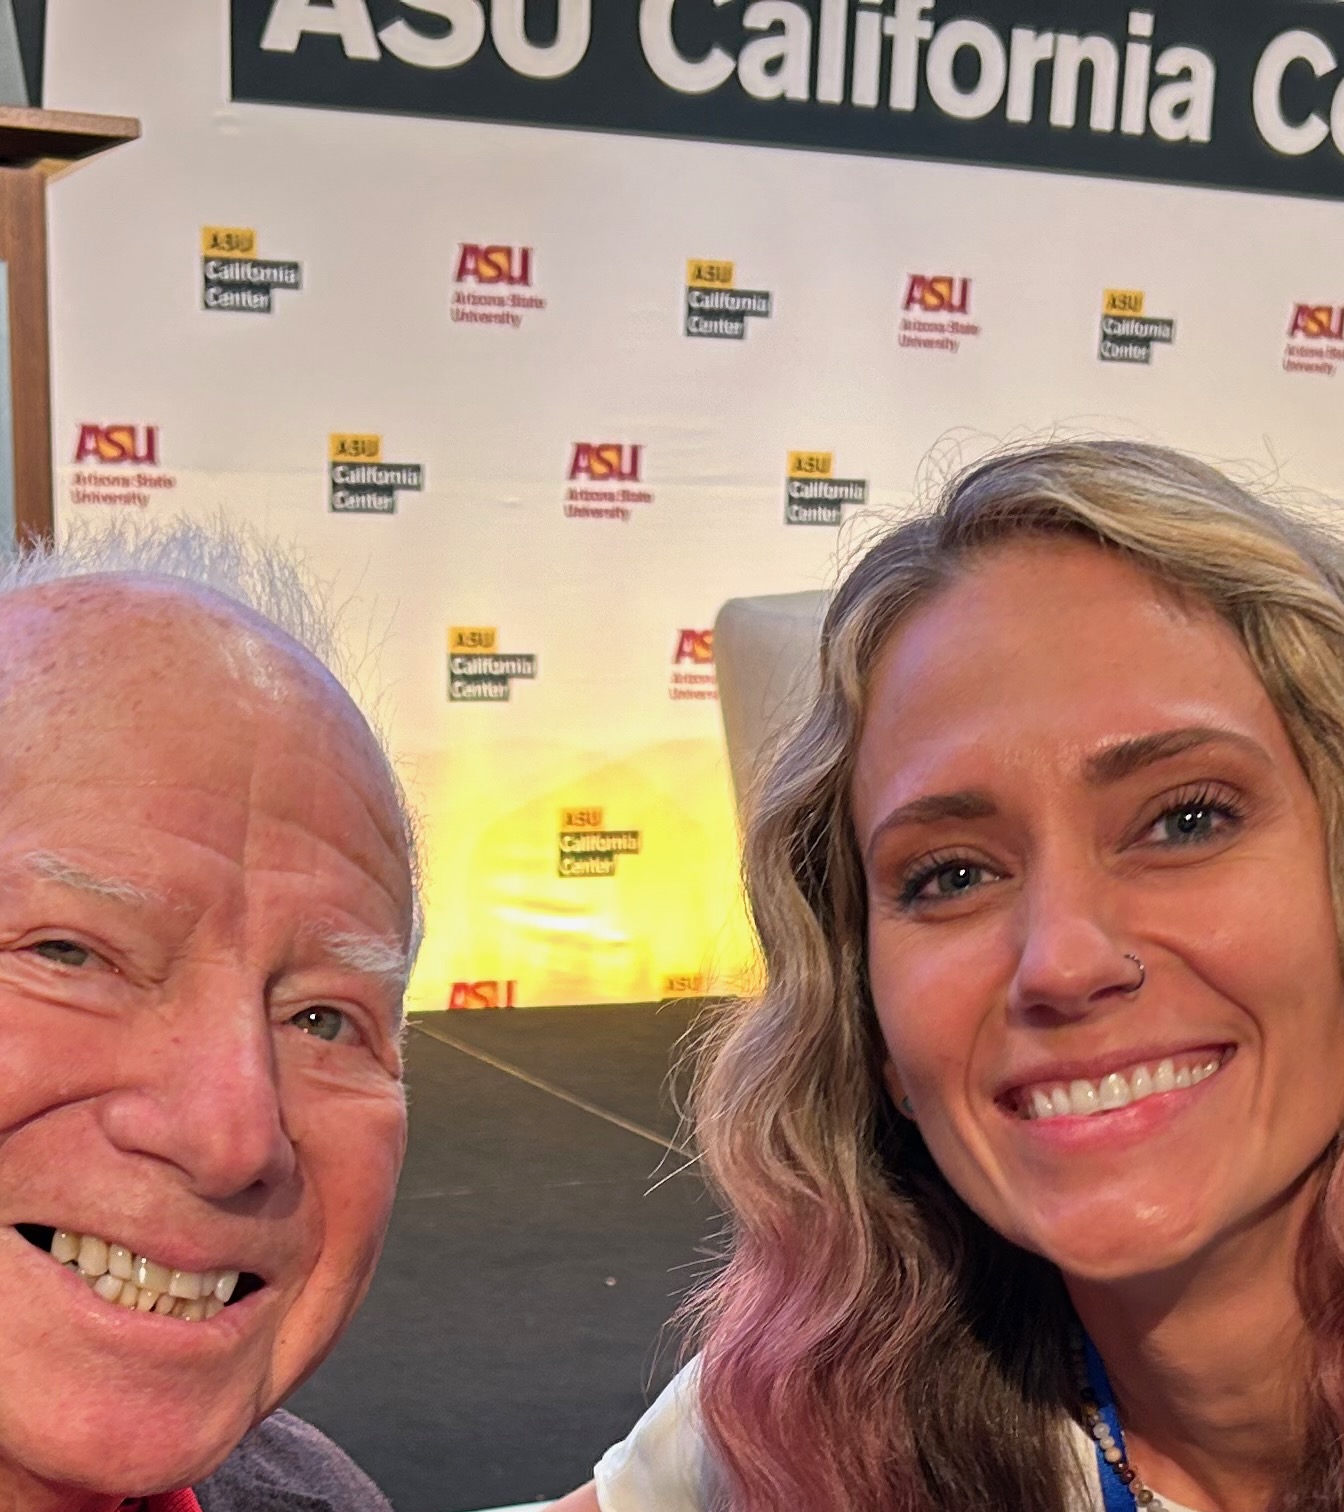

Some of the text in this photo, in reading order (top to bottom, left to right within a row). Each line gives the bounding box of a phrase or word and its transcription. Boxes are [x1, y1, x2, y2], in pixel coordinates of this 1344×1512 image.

[639, 0, 1217, 144] California
[455, 242, 533, 286] ASU
[903, 273, 972, 314] ASU
[75, 424, 159, 464] ASU
[569, 442, 643, 481] ASU
